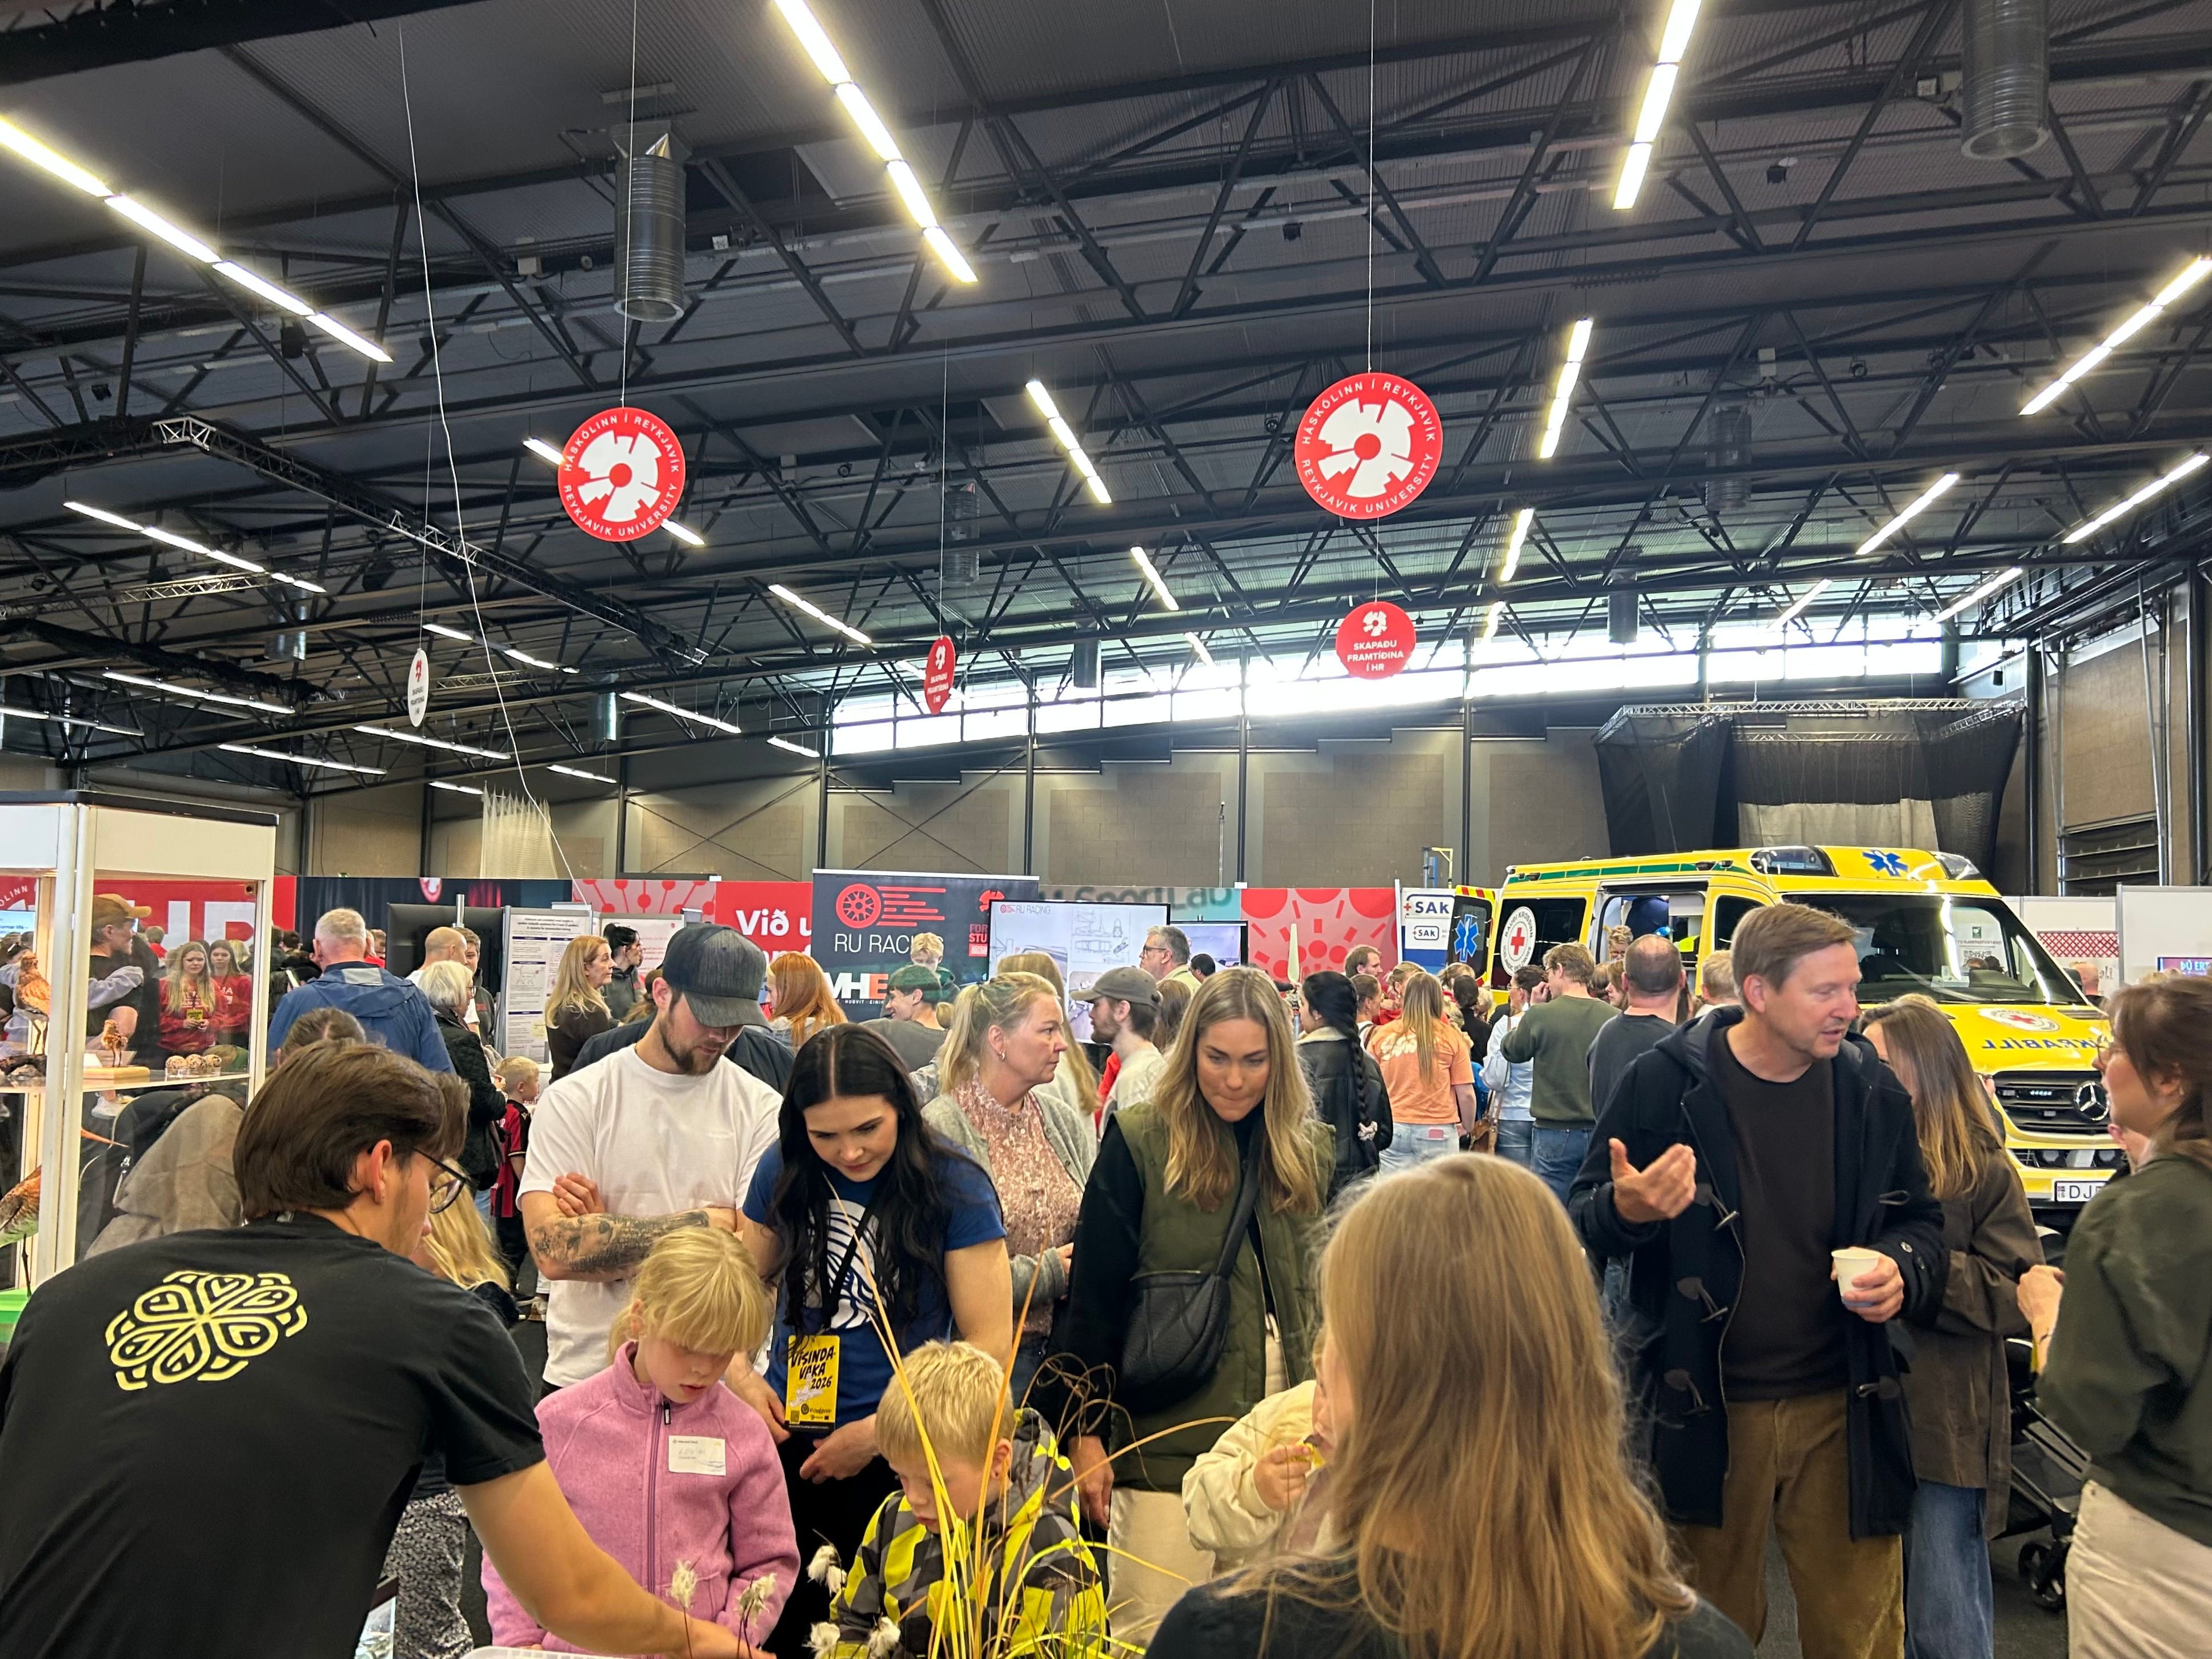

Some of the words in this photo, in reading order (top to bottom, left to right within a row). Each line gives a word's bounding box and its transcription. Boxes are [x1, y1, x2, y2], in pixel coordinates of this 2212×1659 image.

[1302, 381, 1363, 445] HÁSKÓLINN
[1382, 381, 1436, 442] REYKJAVÍK
[564, 415, 618, 472] HÁSKÓLINN
[634, 416, 679, 472] REYKJAVÍK
[1302, 458, 1358, 513] REYKJAVIK
[1365, 453, 1434, 514] UNIVERSITY
[564, 484, 612, 536] REYKJAVIK
[619, 483, 678, 536] UNIVERSITY
[1353, 640, 1397, 651] SKAPAÐU
[1347, 651, 1404, 662] FRAMTÍÐINA
[1027, 905, 1051, 915] RACING
[735, 908, 790, 936] Við
[835, 933, 863, 953] RU
[799, 1362, 826, 1380] VAKA
[811, 1376, 833, 1389] 2026
